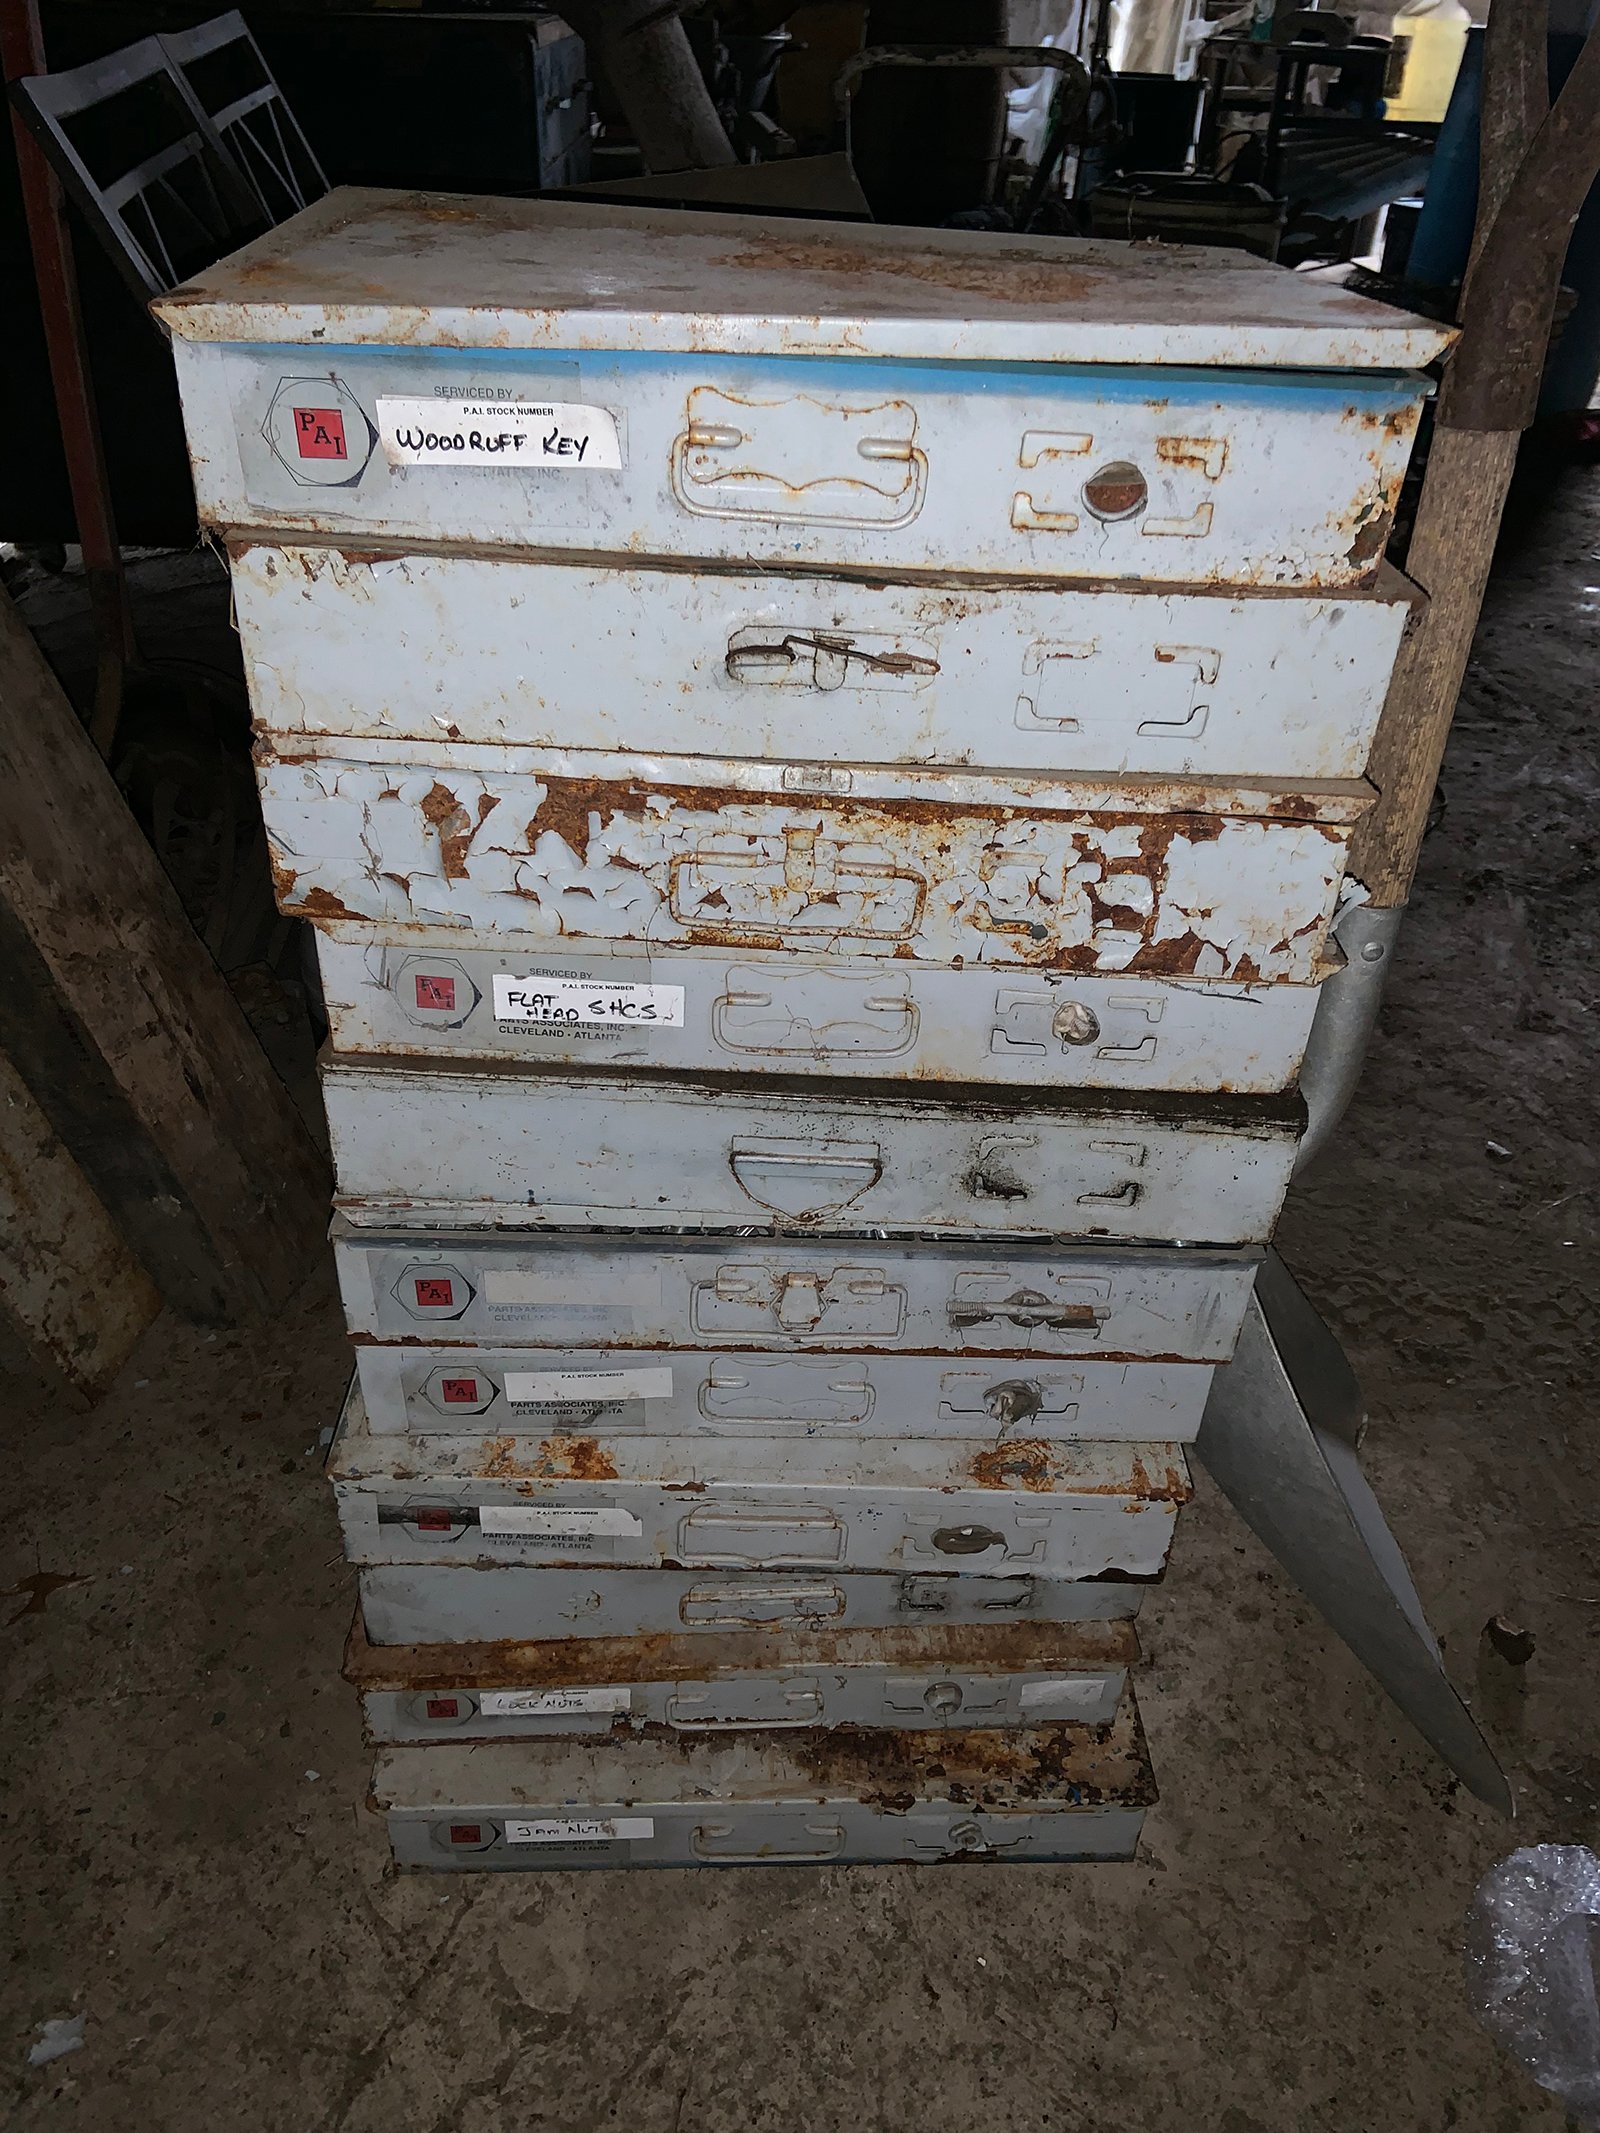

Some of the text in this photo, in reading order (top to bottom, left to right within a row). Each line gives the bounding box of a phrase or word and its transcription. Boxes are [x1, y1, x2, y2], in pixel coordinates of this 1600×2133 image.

[434, 386, 513, 399] SERVICED BY
[463, 406, 554, 417] P.A.I. STOCK NUMBER
[542, 427, 589, 462] KEY
[529, 968, 593, 979] SERVICED BY
[507, 992, 559, 1007] FLAT
[526, 1007, 580, 1021] HEAD
[588, 998, 657, 1020] SHCS
[498, 1026, 622, 1041] CLEVELAND ATLANTA
[606, 1023, 628, 1032] INC.
[551, 1542, 592, 1550] ATLANTA
